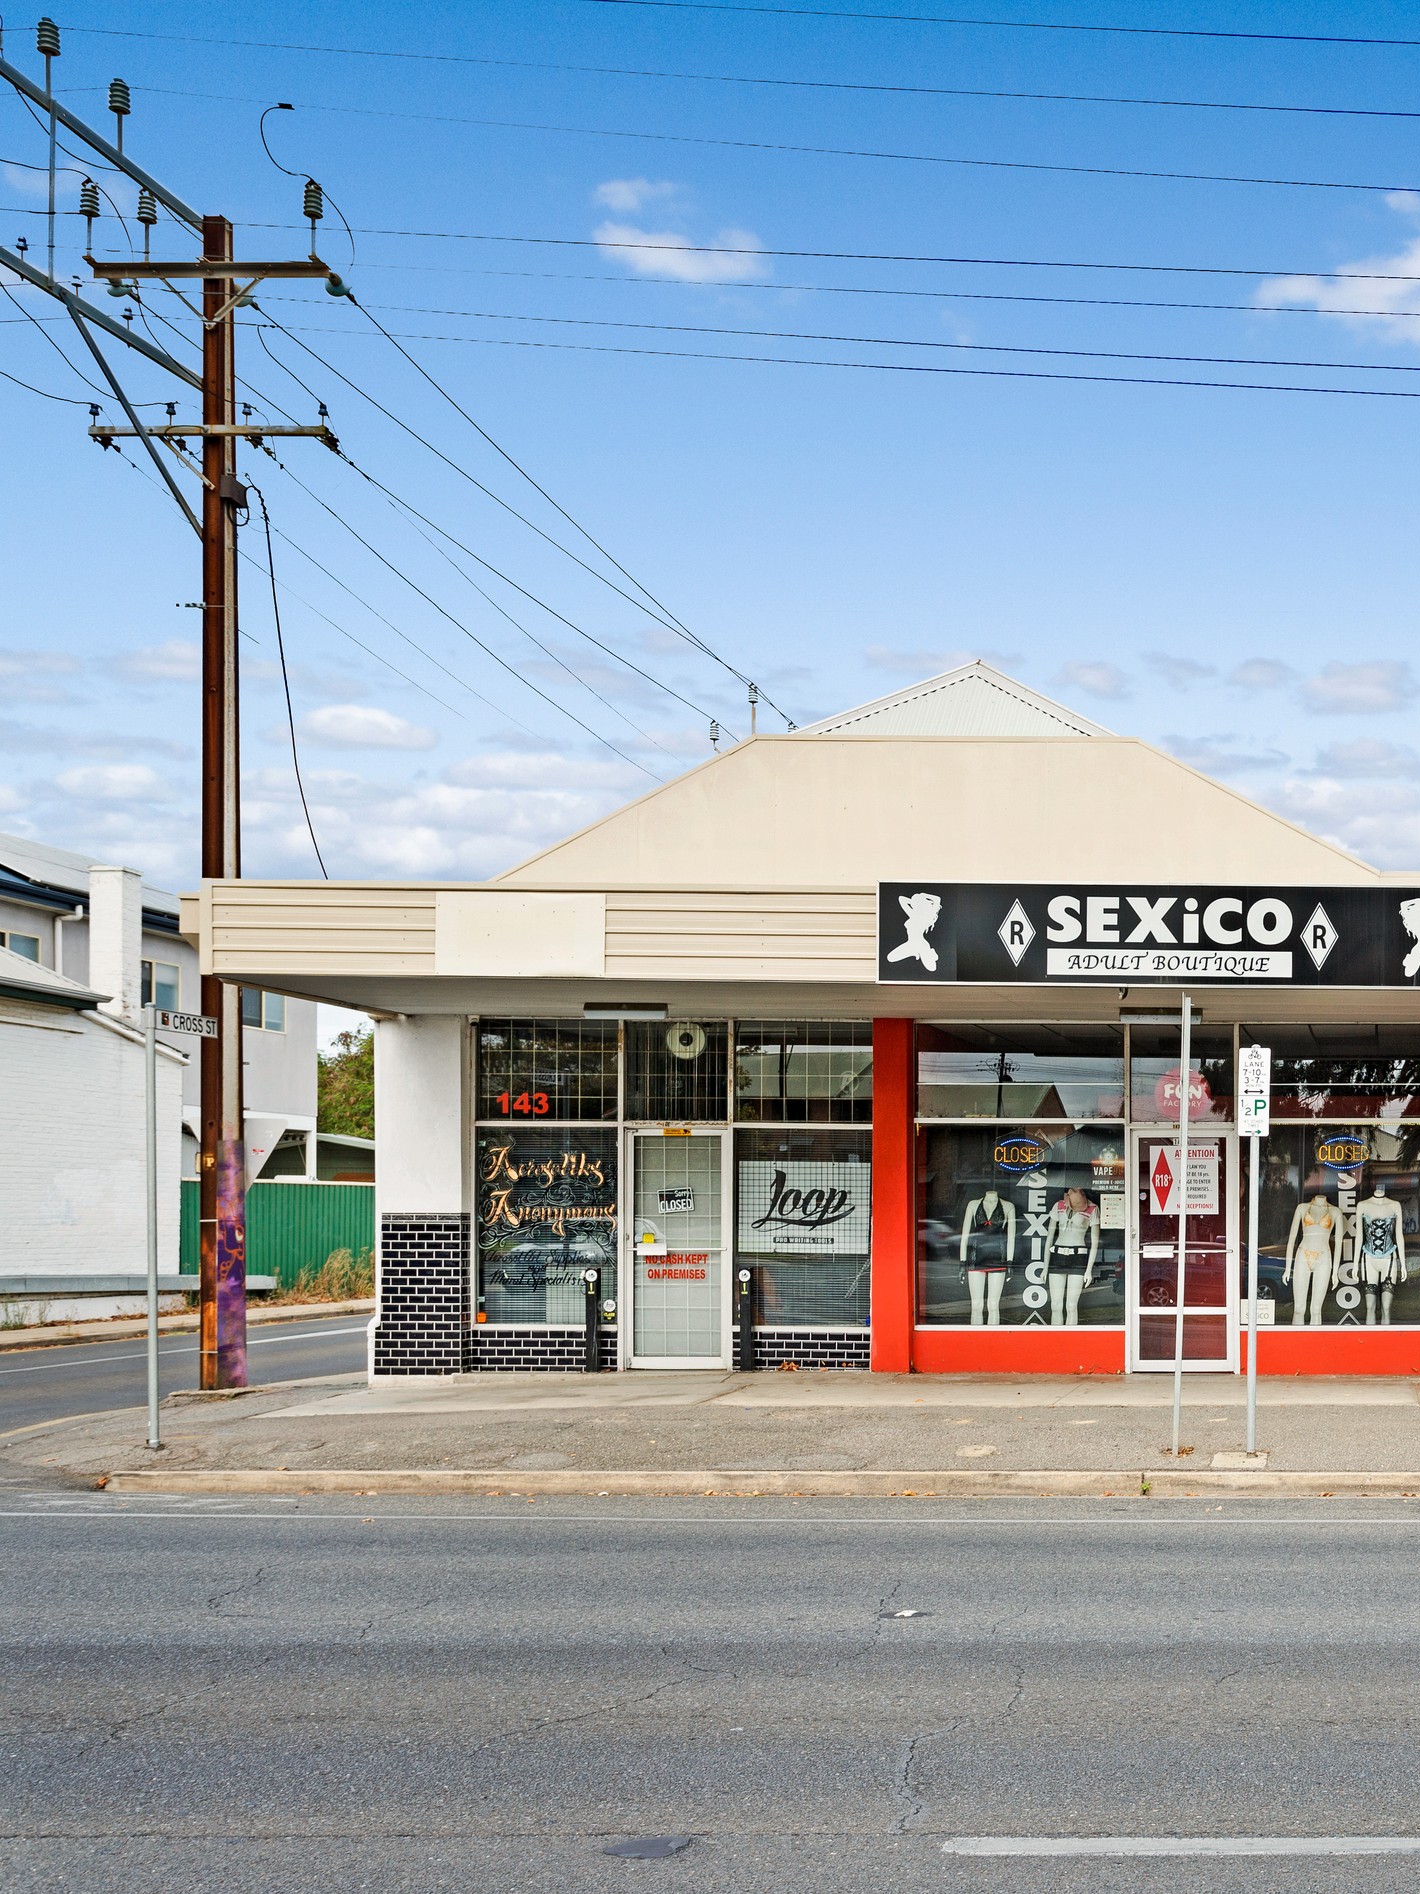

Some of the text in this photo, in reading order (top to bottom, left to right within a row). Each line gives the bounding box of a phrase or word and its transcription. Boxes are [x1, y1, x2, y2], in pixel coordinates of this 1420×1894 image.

[1010, 921, 1024, 945] R
[1313, 925, 1327, 949] R
[1068, 951, 1271, 976] ADULT BOUTIQUE
[172, 1014, 217, 1035] CROSS ST
[496, 1091, 550, 1115] 143
[1163, 1100, 1202, 1108] FACRY
[1254, 1099, 1267, 1116] P
[994, 1146, 1046, 1163] CLOSED
[1317, 1145, 1370, 1162] CLOSED
[1154, 1174, 1172, 1188] R18+
[674, 1189, 691, 1199] Sorry
[751, 1168, 856, 1232] Loop
[482, 1188, 617, 1237] Anonymous
[660, 1198, 692, 1212] CLOSED
[1022, 1167, 1050, 1309] SEXICO
[545, 1248, 591, 1271] Supplies
[645, 1254, 708, 1265] NO CASH KEPT
[647, 1269, 706, 1280] ON PREMISES
